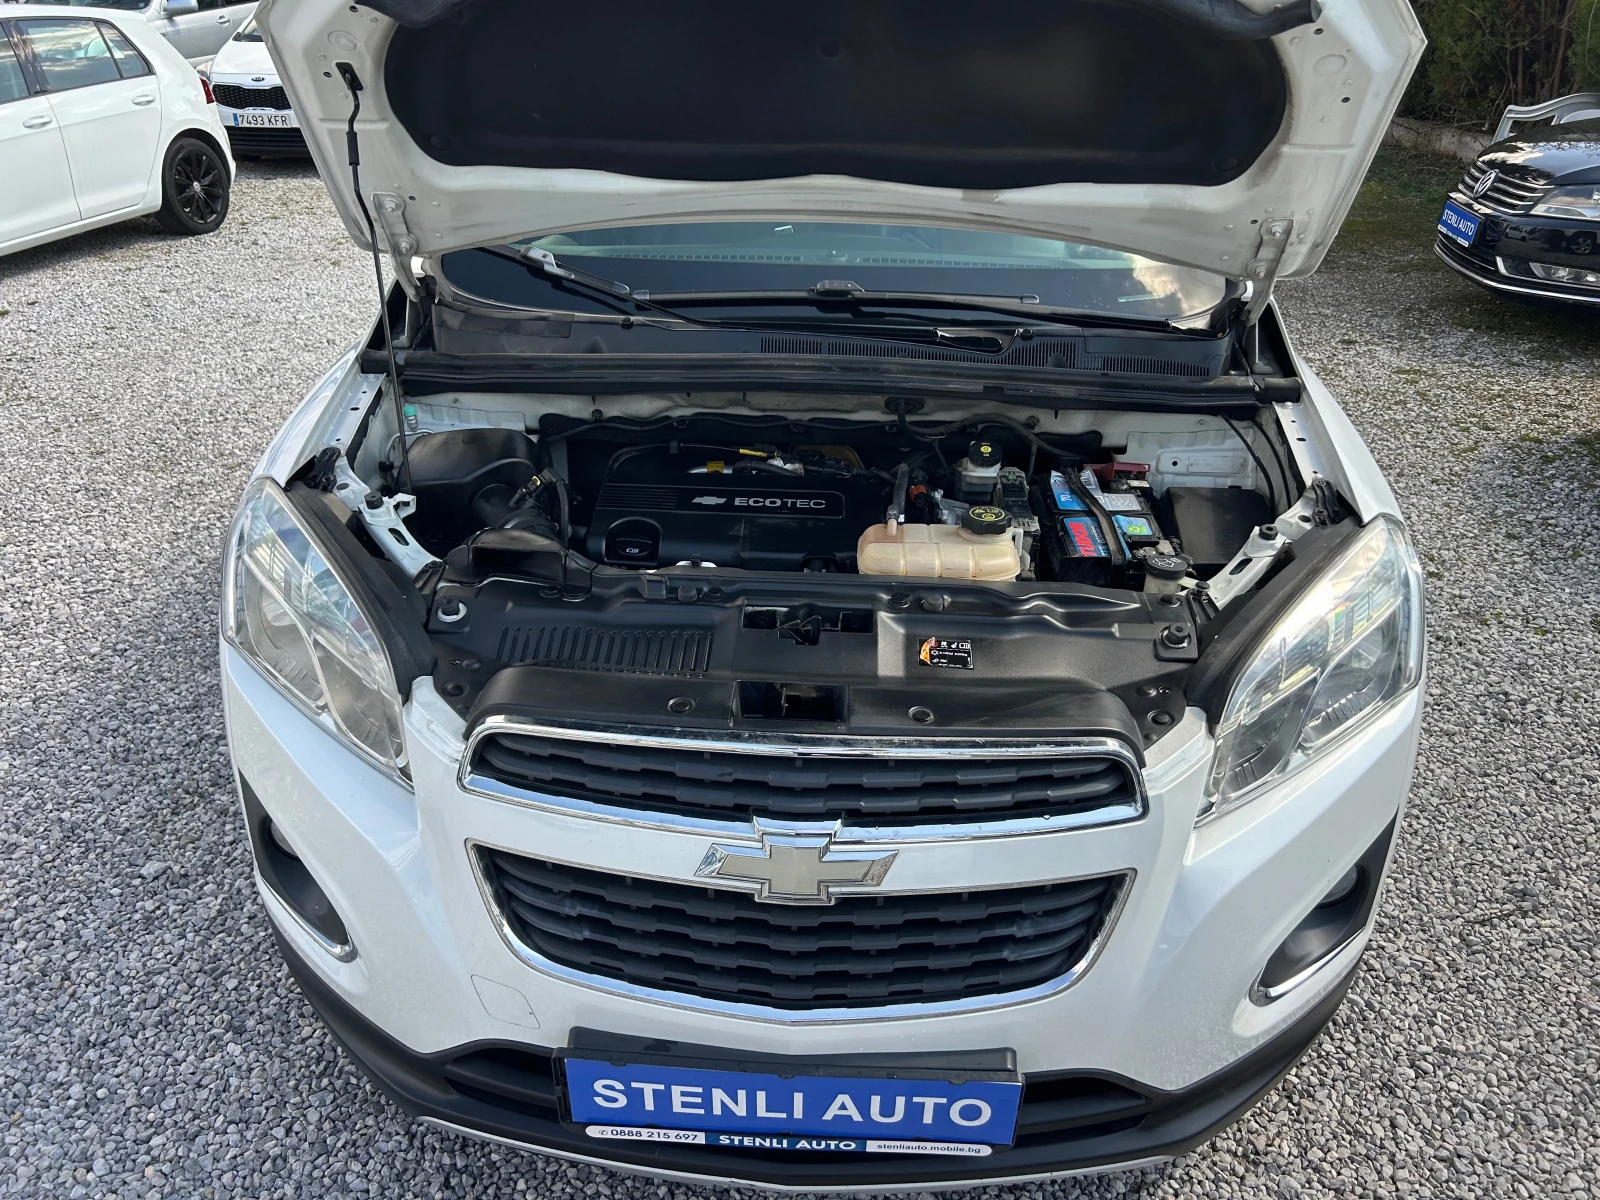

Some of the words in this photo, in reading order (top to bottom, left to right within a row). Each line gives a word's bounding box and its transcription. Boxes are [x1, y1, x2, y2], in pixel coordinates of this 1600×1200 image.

[239, 115, 265, 126] 7493
[267, 115, 288, 126] KFR
[1442, 208, 1460, 228] STENLI
[1458, 218, 1474, 236] AUTO
[734, 497, 826, 509] ECOTEC
[1068, 521, 1098, 556] TUDOR
[592, 1078, 804, 1119] STENLI
[821, 1093, 992, 1126] AUTO
[610, 1128, 642, 1138] 0888
[646, 1130, 671, 1140] 215
[674, 1131, 698, 1142] 697
[719, 1135, 788, 1148] STENLI
[795, 1139, 857, 1150] AUTO
[877, 1142, 981, 1154] stenliauto.mobile.bg
